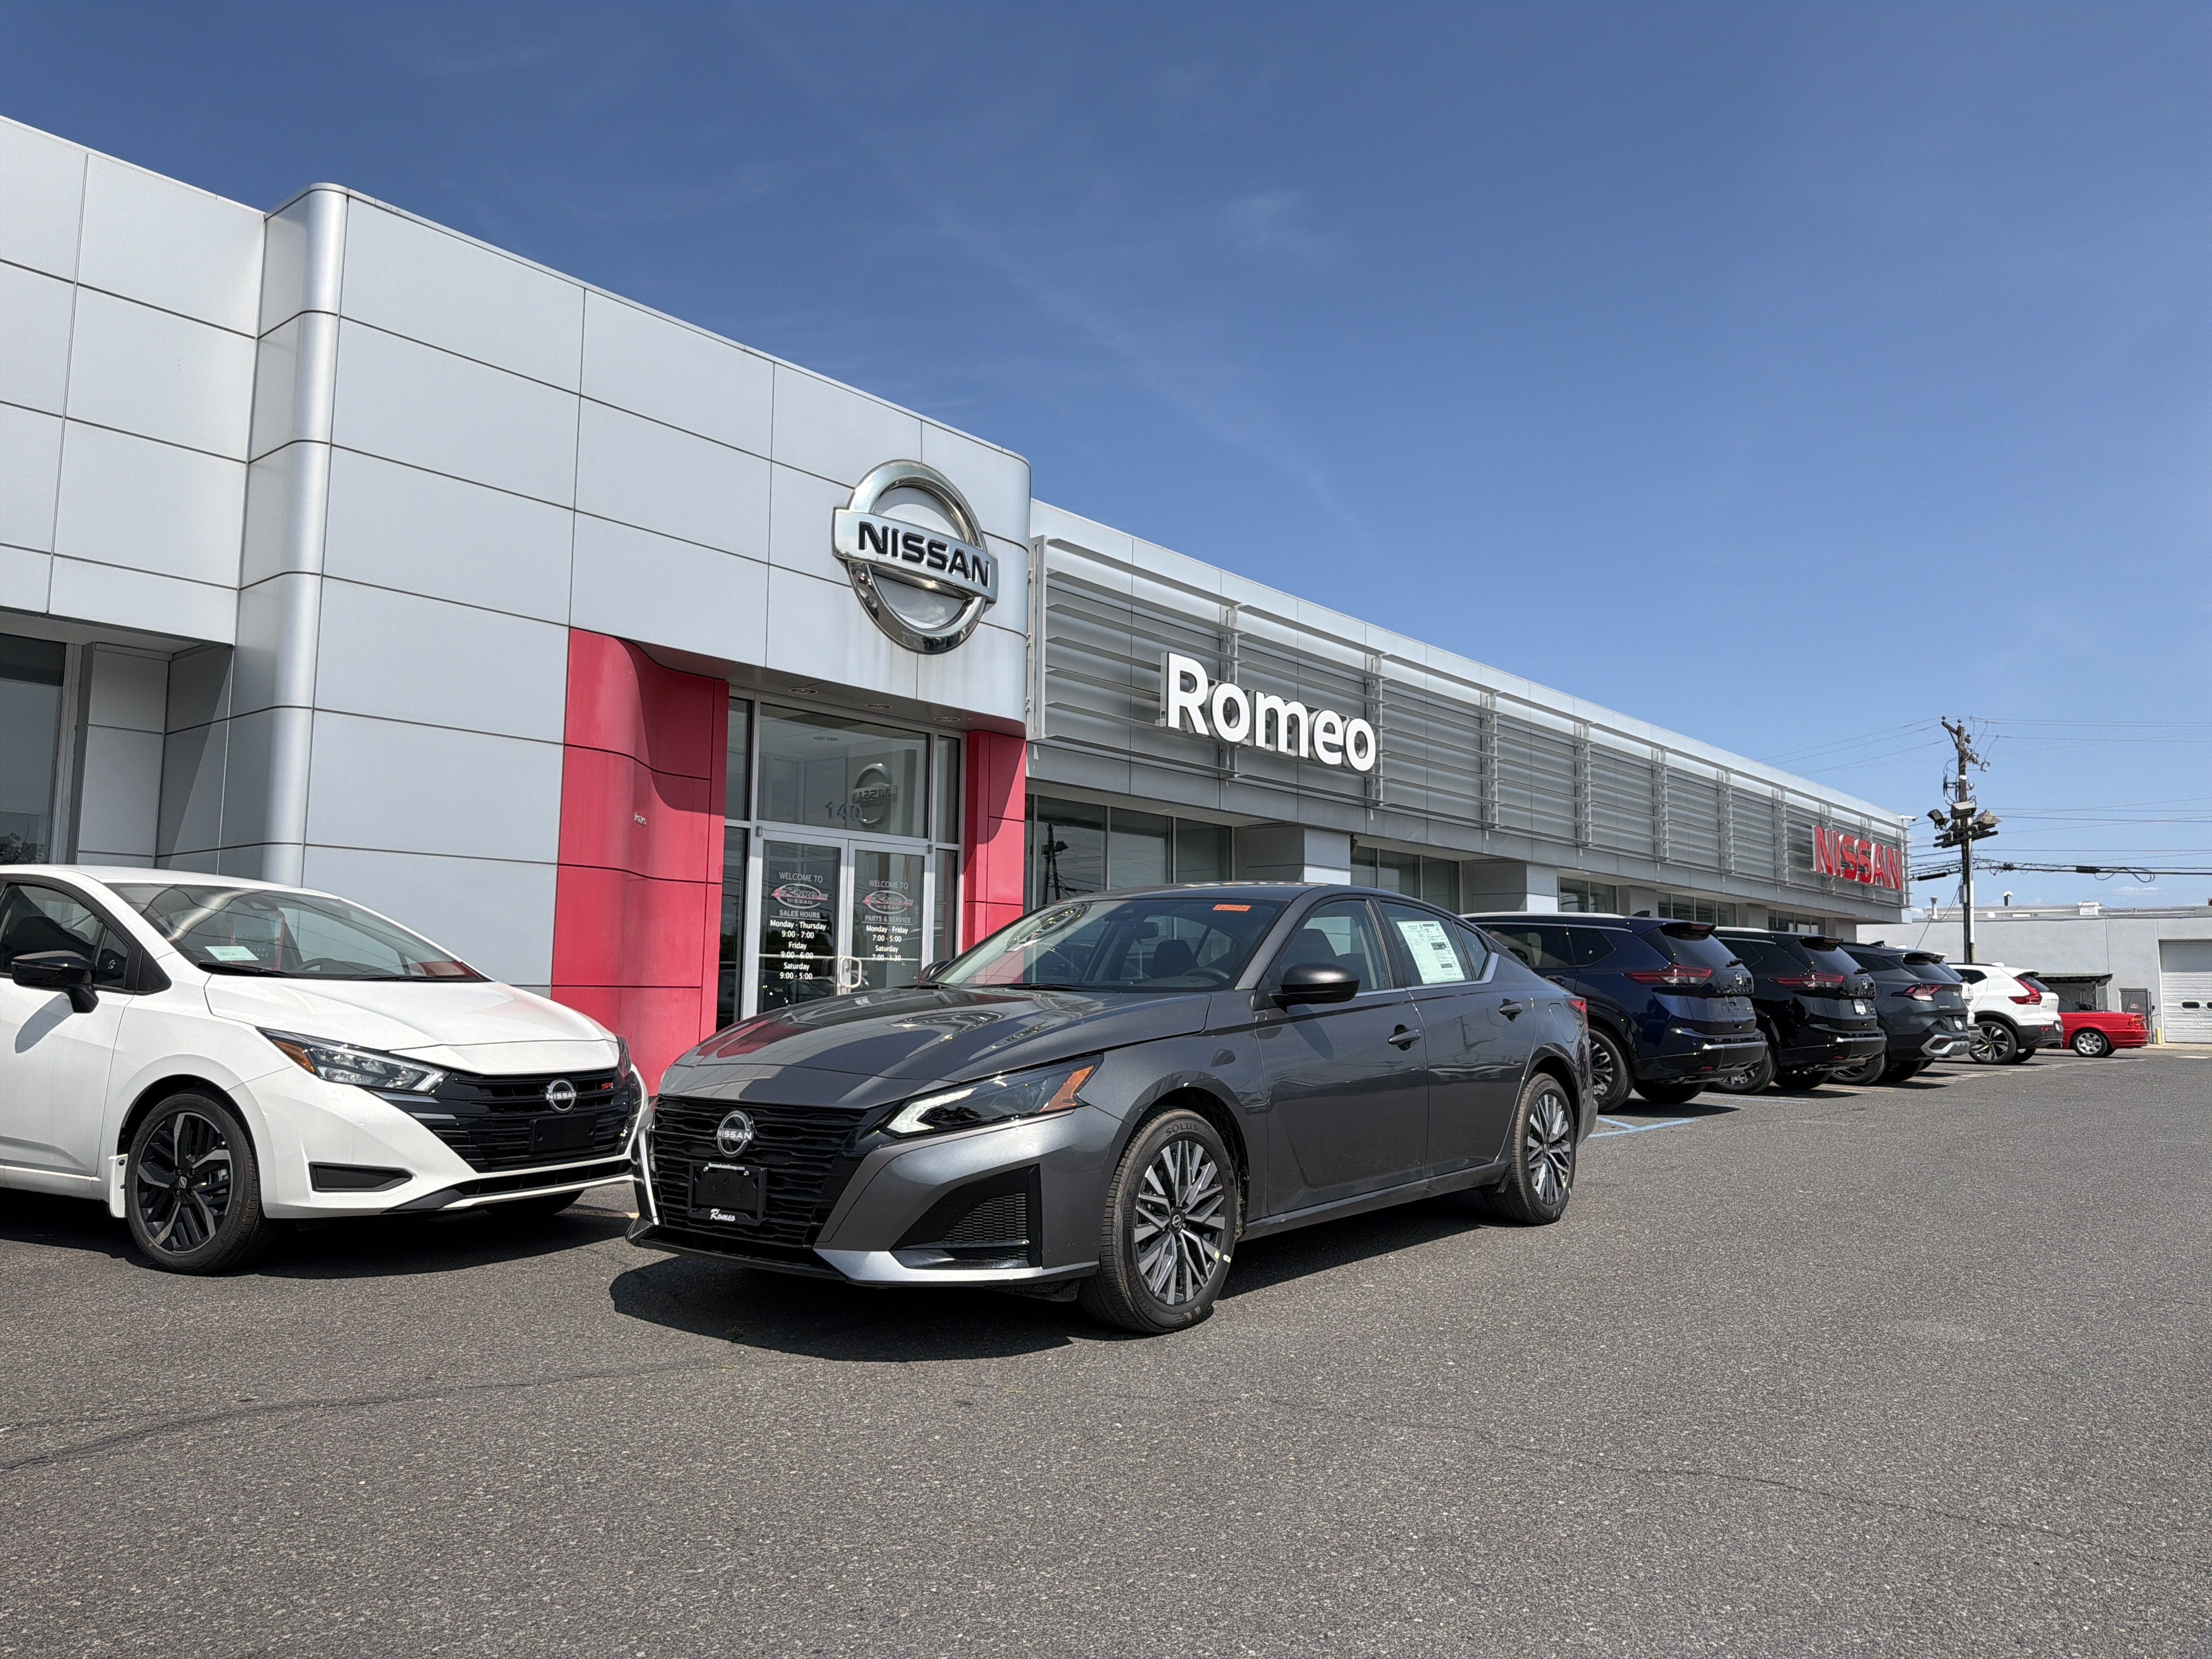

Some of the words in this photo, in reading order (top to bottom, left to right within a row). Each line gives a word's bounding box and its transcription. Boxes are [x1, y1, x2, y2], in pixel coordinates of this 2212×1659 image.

[858, 521, 990, 588] NISSAN
[1164, 651, 1376, 771] Romeo
[1813, 825, 1902, 891] NISSAN
[779, 872, 812, 882] WELCOME
[813, 875, 823, 883] TO
[868, 879, 898, 889] WELCOME
[781, 885, 820, 899] Romeo
[770, 919, 794, 929] Monday
[799, 922, 826, 931] Thursday
[866, 925, 888, 934] Monday
[891, 926, 909, 935] Friday
[781, 930, 795, 938] 9:00
[788, 941, 808, 950] Friday
[875, 944, 899, 953] Saturday
[783, 962, 810, 971] Saturday
[546, 1092, 577, 1100] NISSAN
[716, 1129, 752, 1139] NISSAN
[1165, 1122, 1198, 1137] SOLUS
[710, 1208, 736, 1222] Romeo
